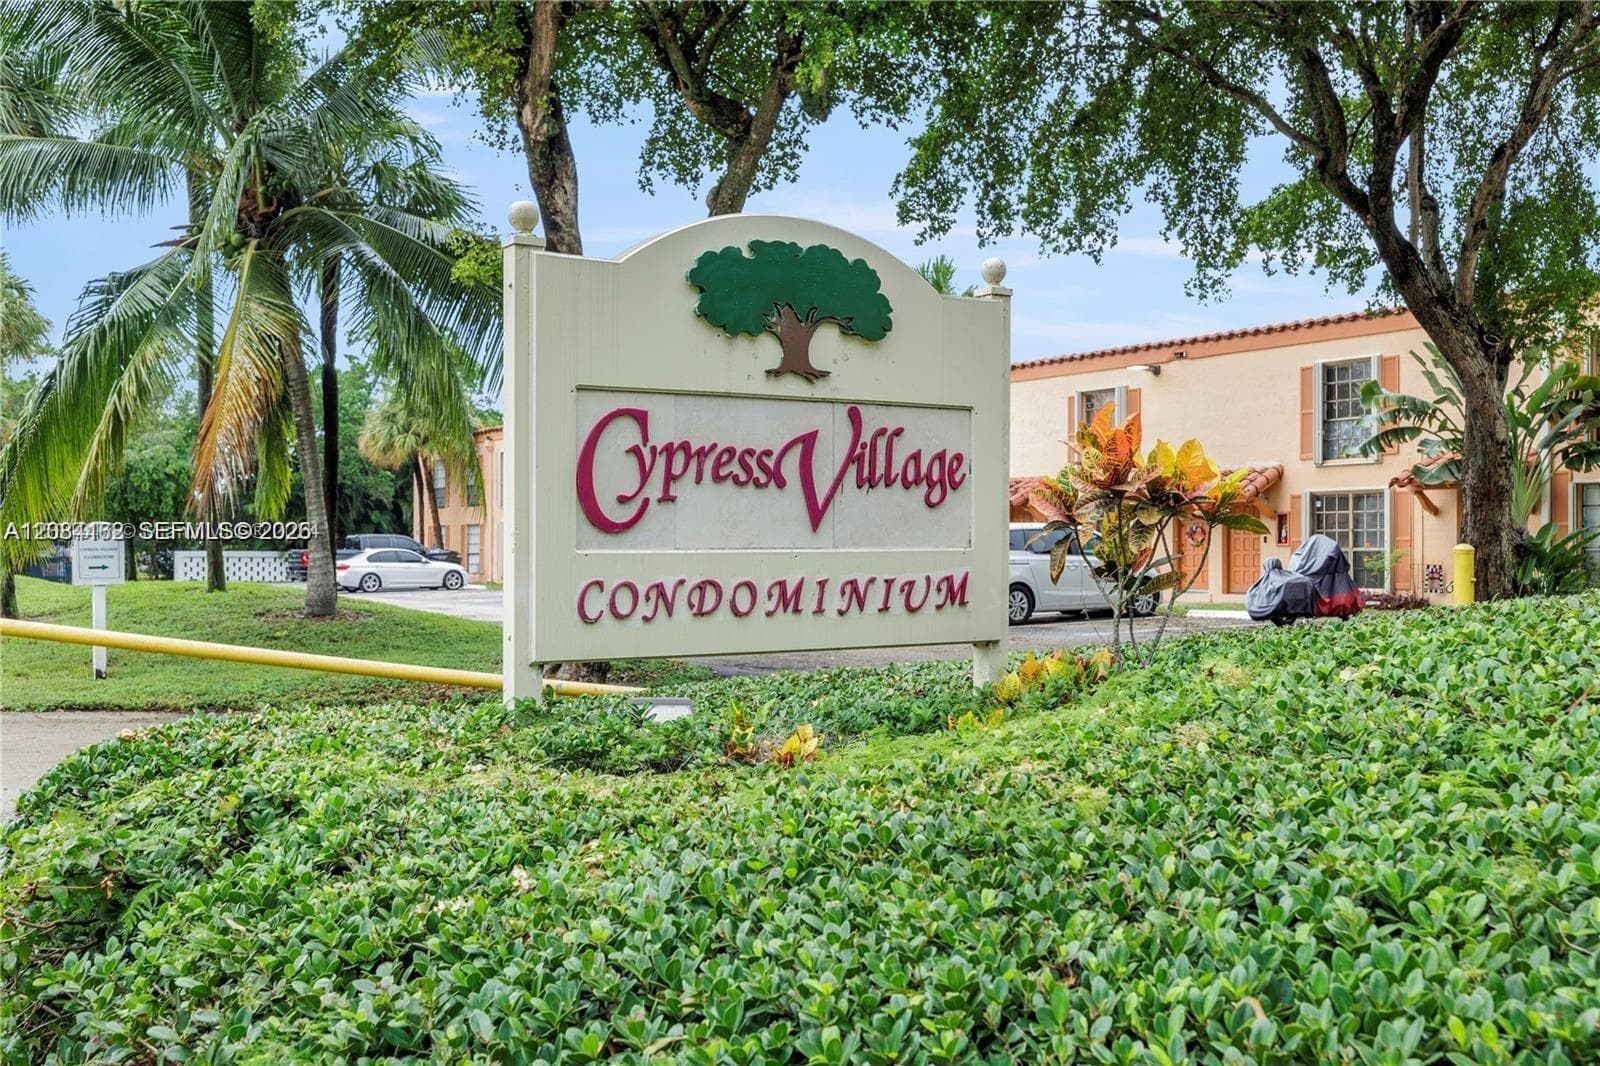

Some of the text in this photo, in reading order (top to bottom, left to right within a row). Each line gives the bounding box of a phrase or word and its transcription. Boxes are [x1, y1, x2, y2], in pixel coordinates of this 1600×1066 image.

[576, 405, 966, 534] Cypress Village
[577, 571, 970, 625] CONDOMINIUM
